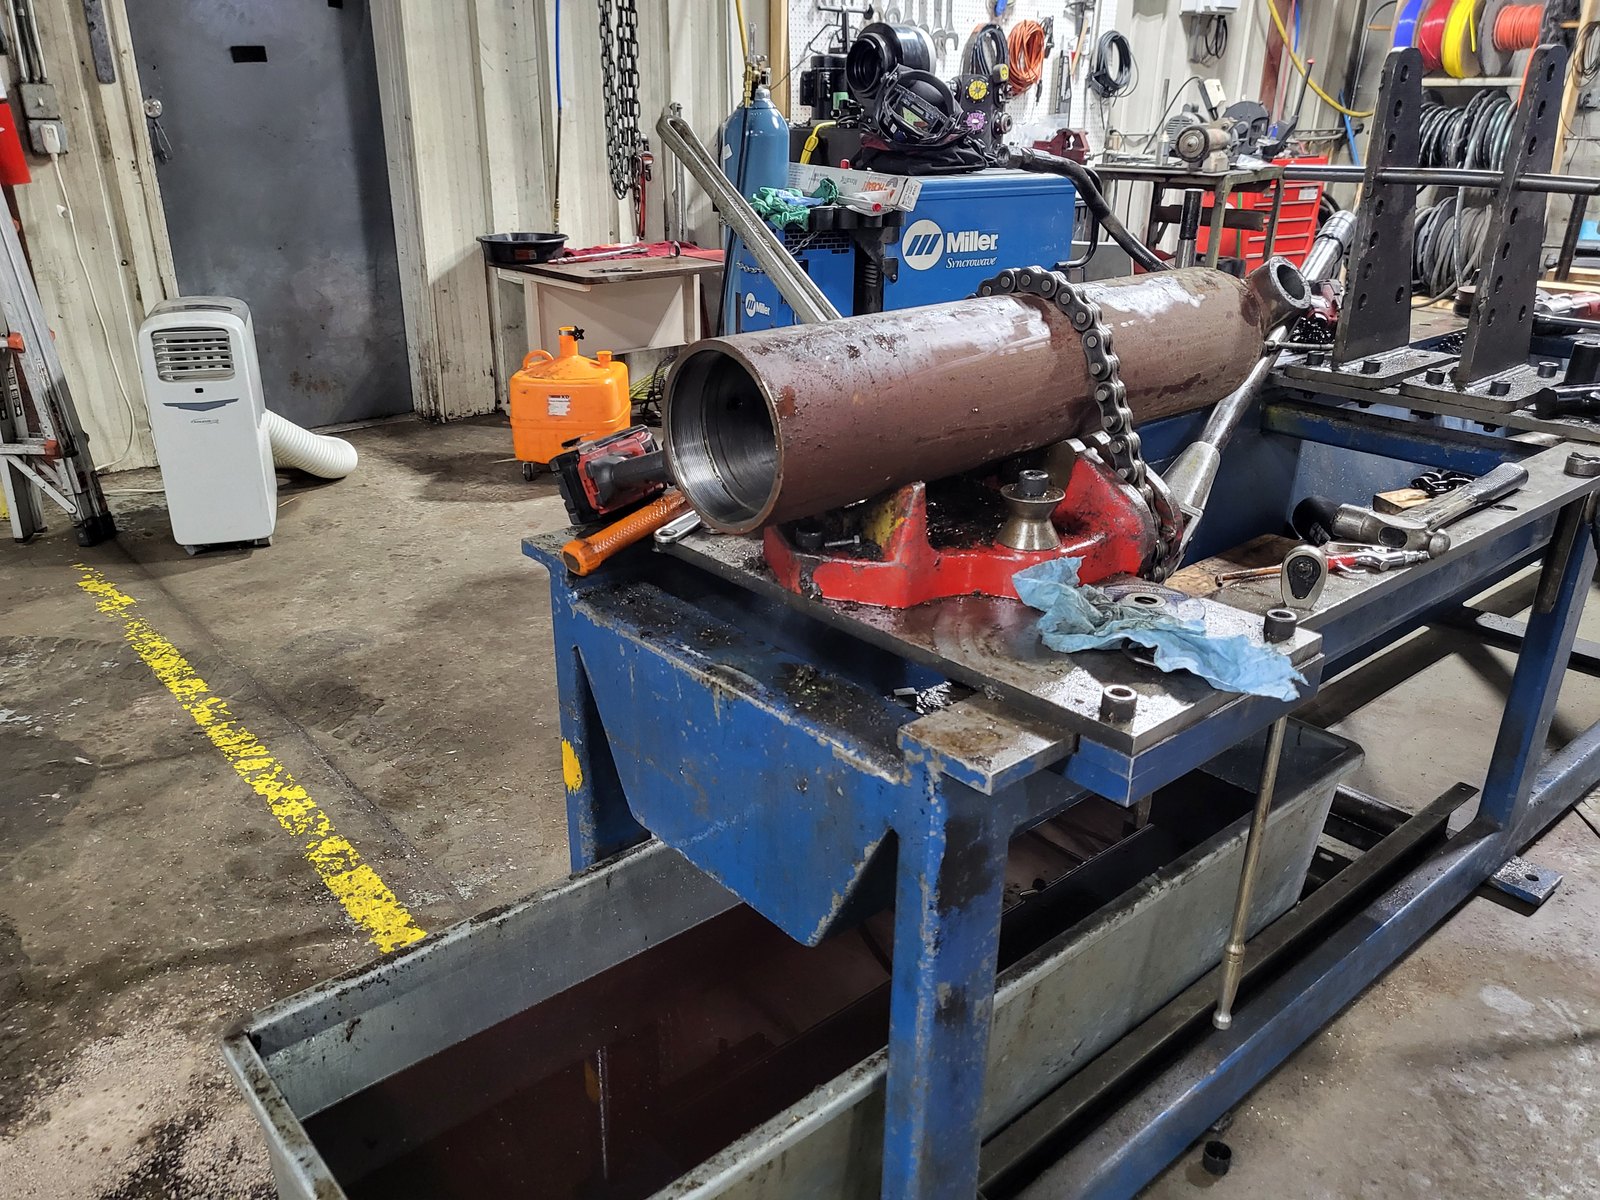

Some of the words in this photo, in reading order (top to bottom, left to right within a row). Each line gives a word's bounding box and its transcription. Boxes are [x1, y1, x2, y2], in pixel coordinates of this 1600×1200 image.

[946, 230, 999, 254] Miller
[945, 256, 998, 269] Syncrowave
[755, 301, 770, 316] Miller
